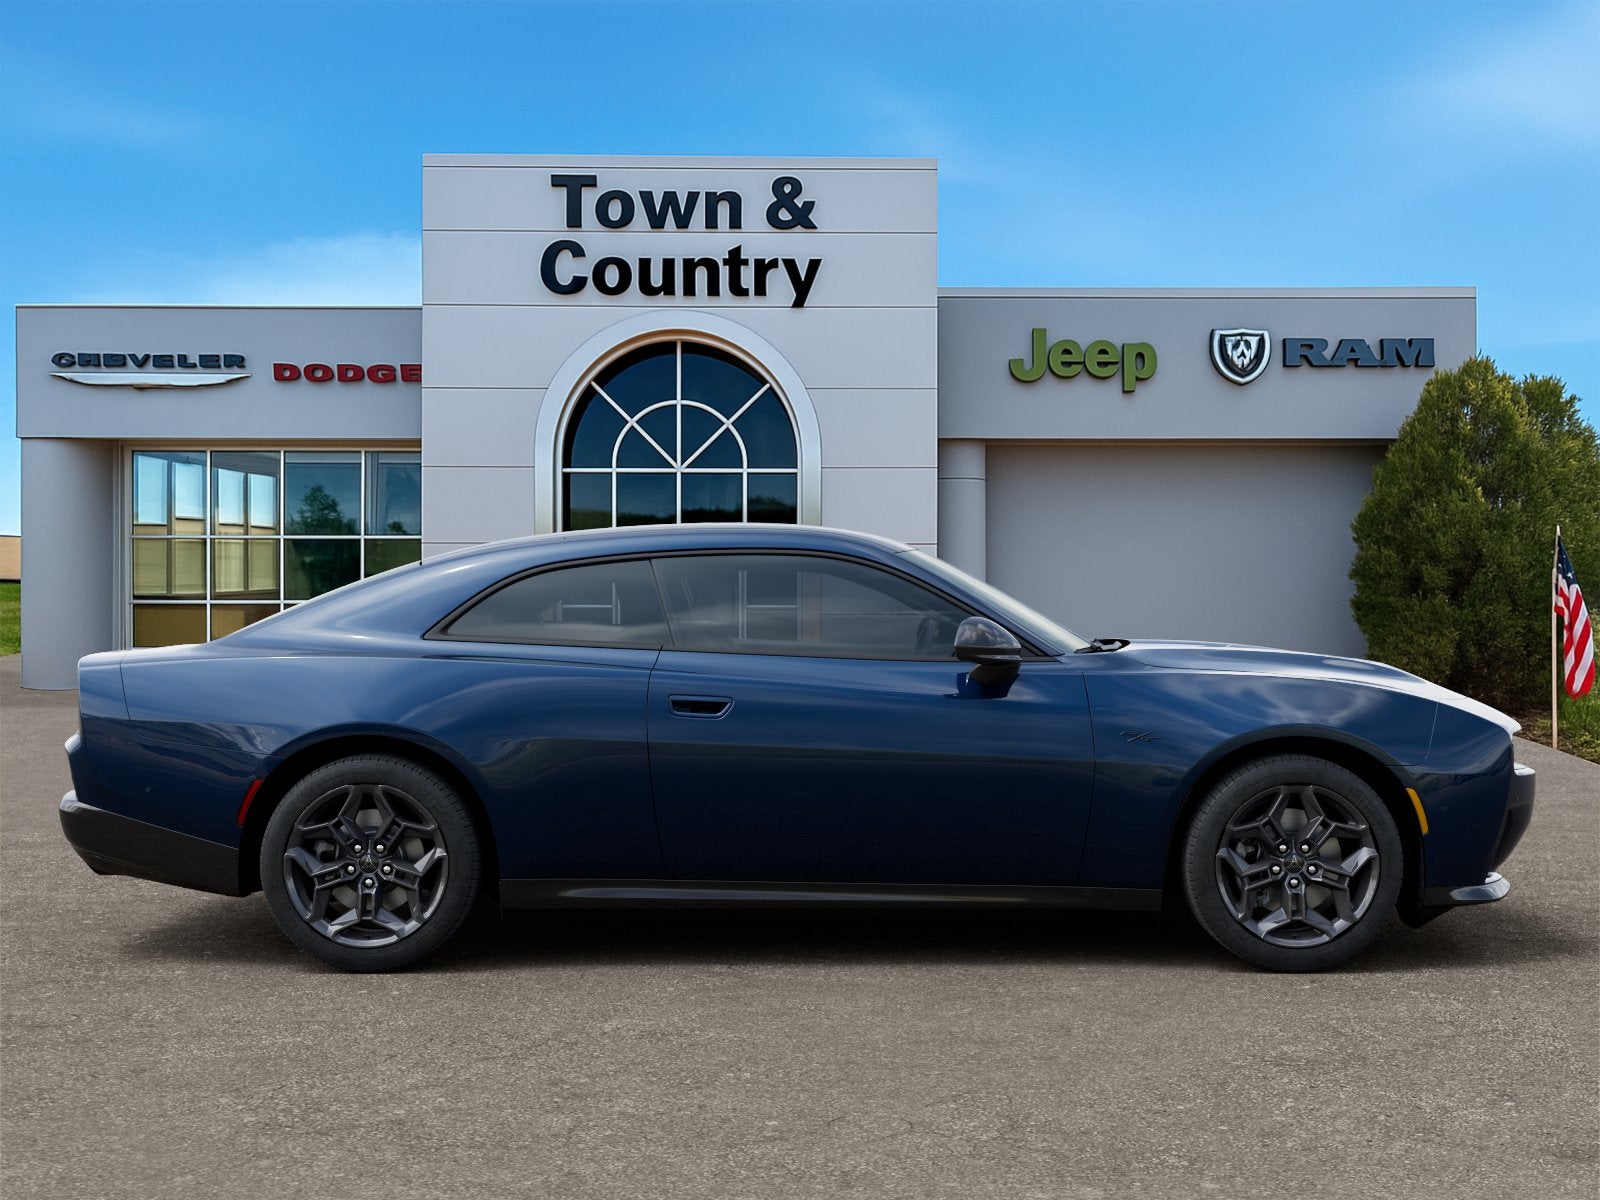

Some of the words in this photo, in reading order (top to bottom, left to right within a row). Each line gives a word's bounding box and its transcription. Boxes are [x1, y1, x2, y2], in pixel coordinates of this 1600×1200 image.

[550, 174, 743, 229] Town
[766, 175, 818, 230] &
[540, 239, 823, 308] Country
[272, 363, 422, 383] DODGE
[1009, 328, 1157, 393] Jeep
[1282, 337, 1436, 368] RAM
